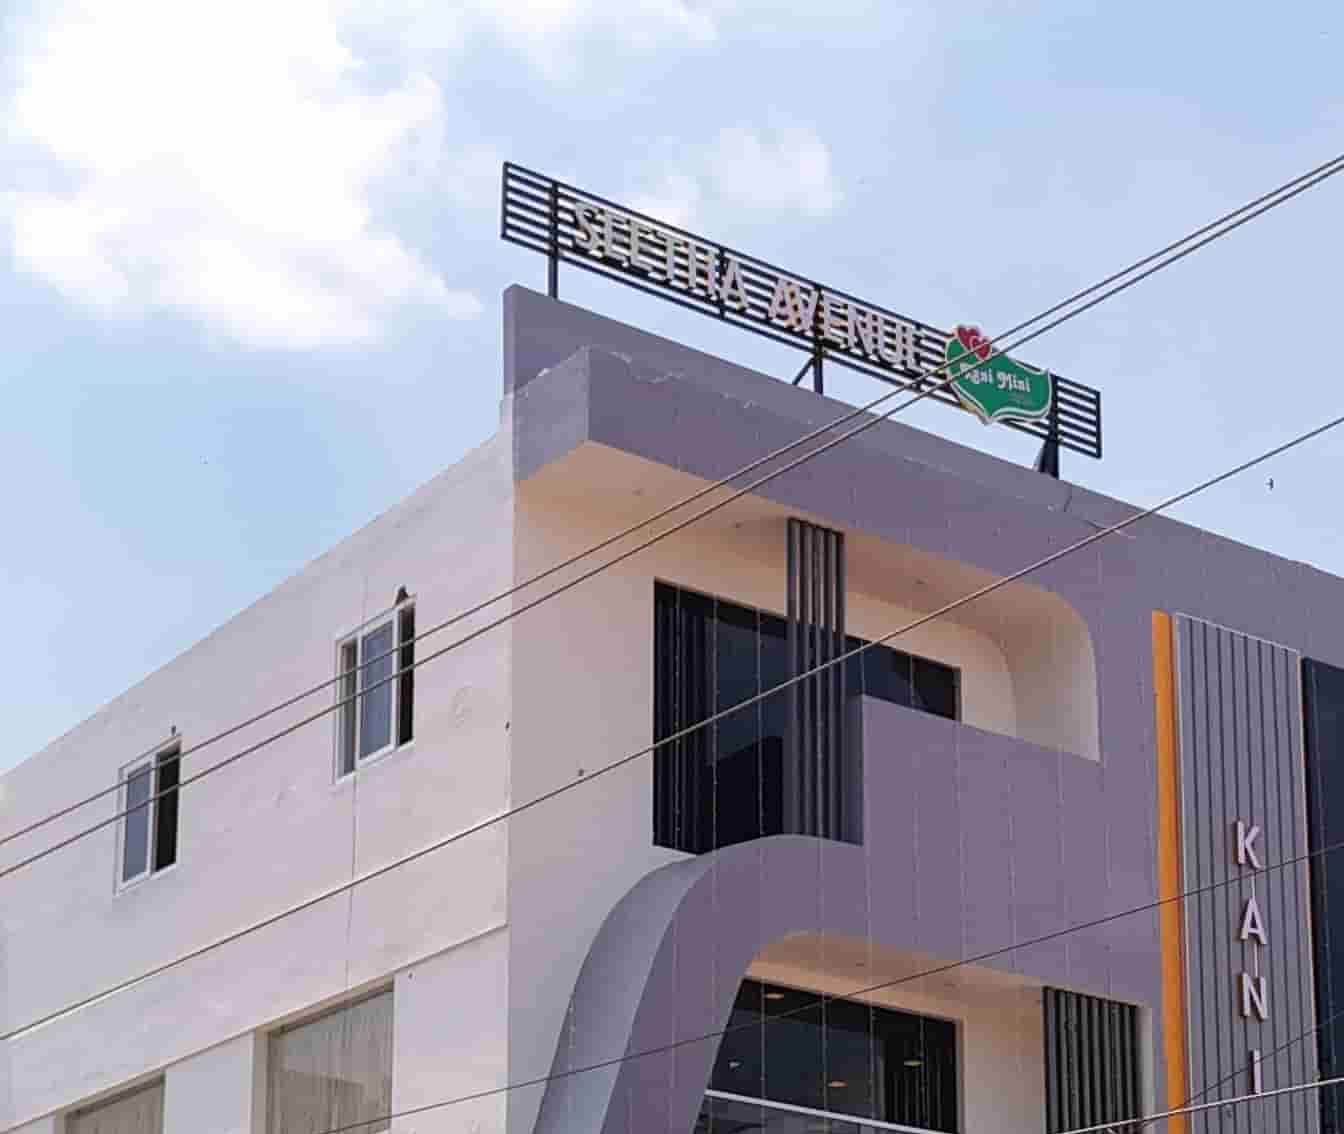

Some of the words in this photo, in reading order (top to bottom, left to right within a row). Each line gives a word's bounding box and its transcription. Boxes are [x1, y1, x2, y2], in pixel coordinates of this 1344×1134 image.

[574, 201, 750, 312] SEETHA
[767, 277, 931, 375] AVENUE
[1234, 820, 1269, 1097] KANI
